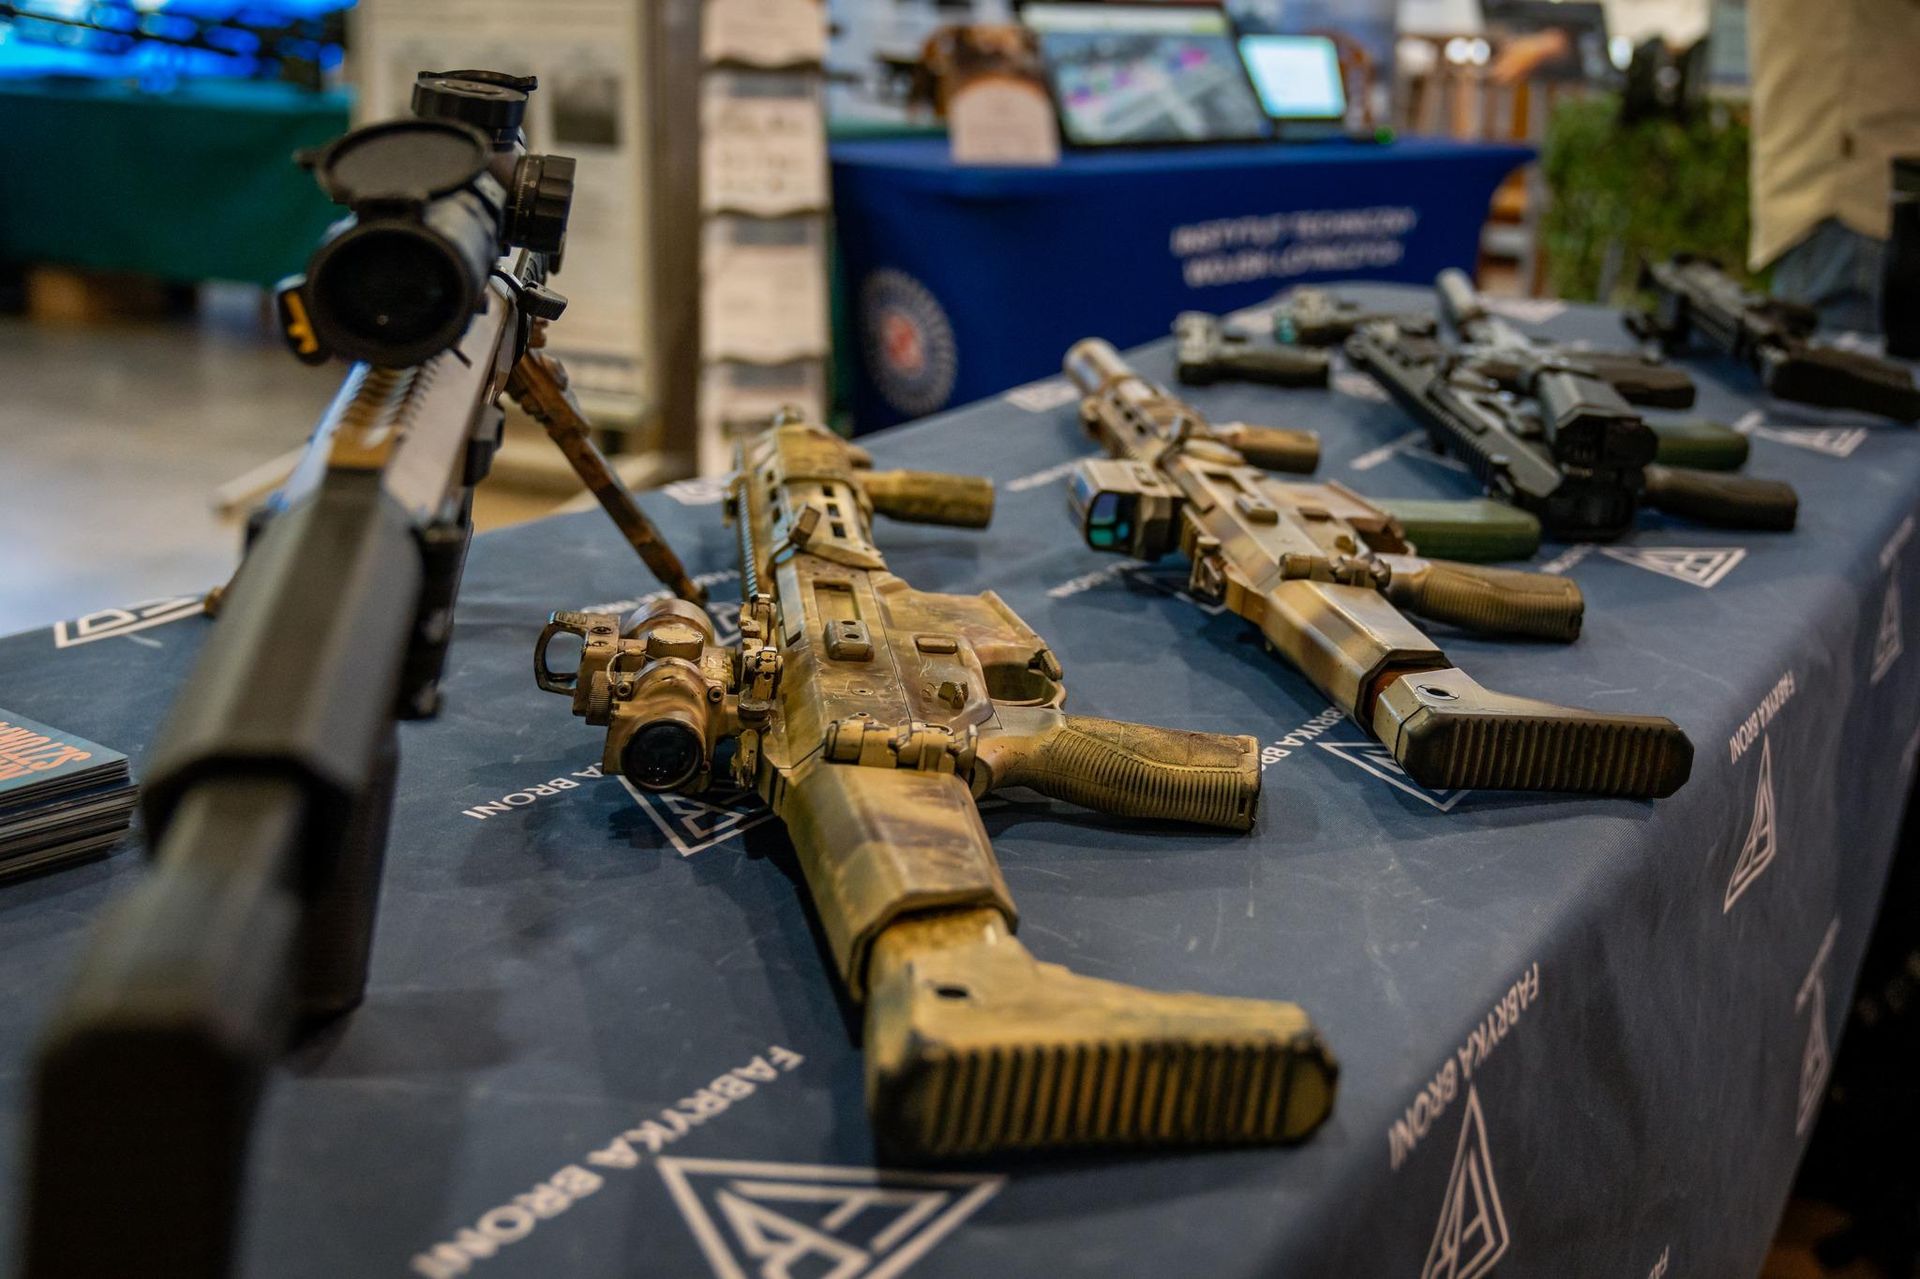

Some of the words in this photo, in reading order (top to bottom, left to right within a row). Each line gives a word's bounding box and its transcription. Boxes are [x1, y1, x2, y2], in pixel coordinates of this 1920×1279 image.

[1728, 710, 1760, 766] BRONI
[461, 777, 580, 820] BRONI
[1457, 961, 1540, 1079] FABRYKA
[586, 1045, 805, 1169] FABRYKA
[1388, 1057, 1459, 1171] BRONI
[410, 1163, 604, 1279] BRONI
